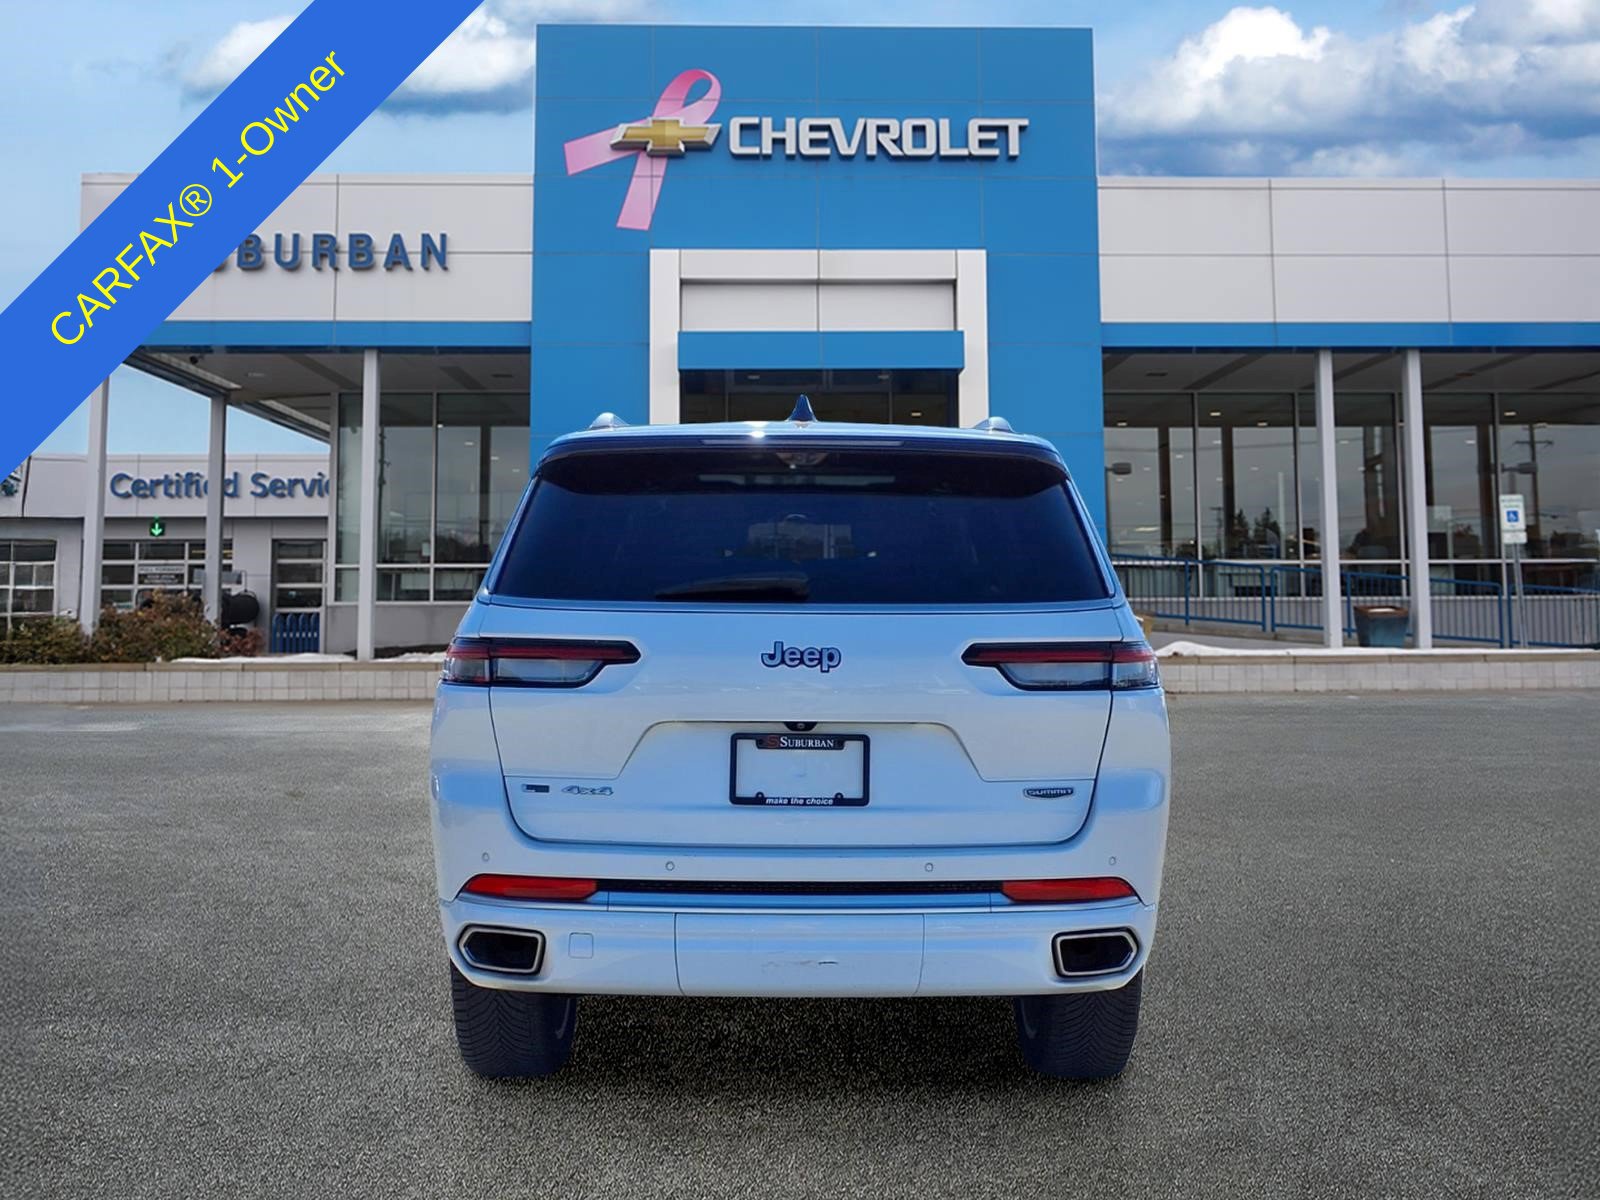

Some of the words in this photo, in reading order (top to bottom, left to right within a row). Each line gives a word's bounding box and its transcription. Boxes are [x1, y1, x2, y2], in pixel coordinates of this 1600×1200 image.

[729, 117, 1029, 158] CHEVROLET
[214, 233, 448, 271] BURBAN
[110, 472, 240, 499] Certifid
[250, 472, 330, 499] Servi
[761, 641, 841, 673] Jeep
